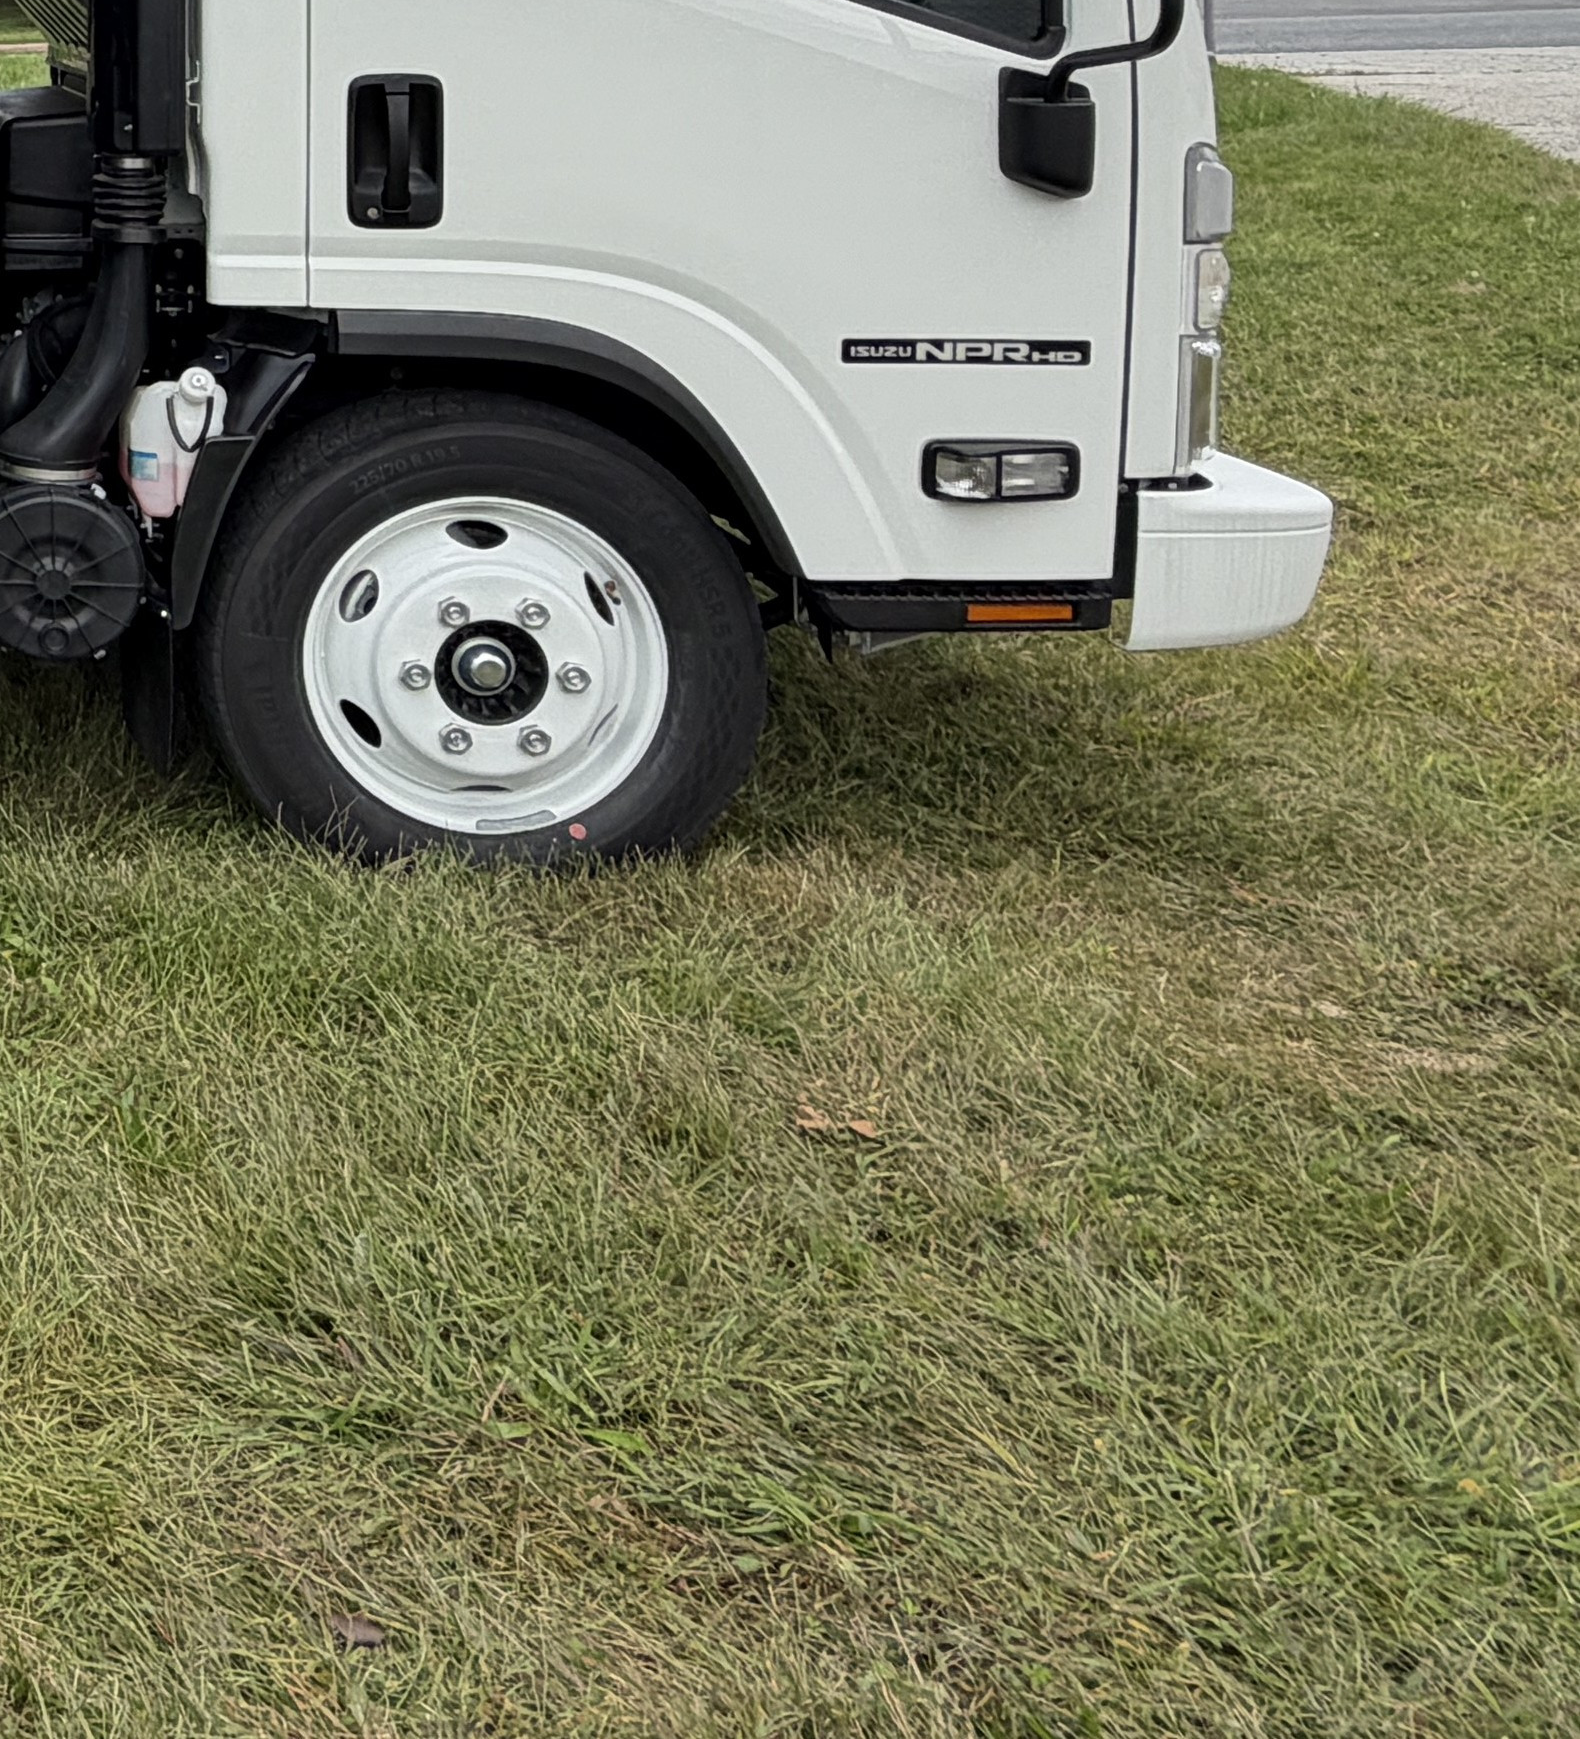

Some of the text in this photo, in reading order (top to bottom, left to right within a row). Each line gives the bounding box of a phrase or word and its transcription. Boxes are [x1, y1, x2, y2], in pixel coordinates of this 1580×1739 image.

[849, 341, 1082, 363] ISUZU NPR HD
